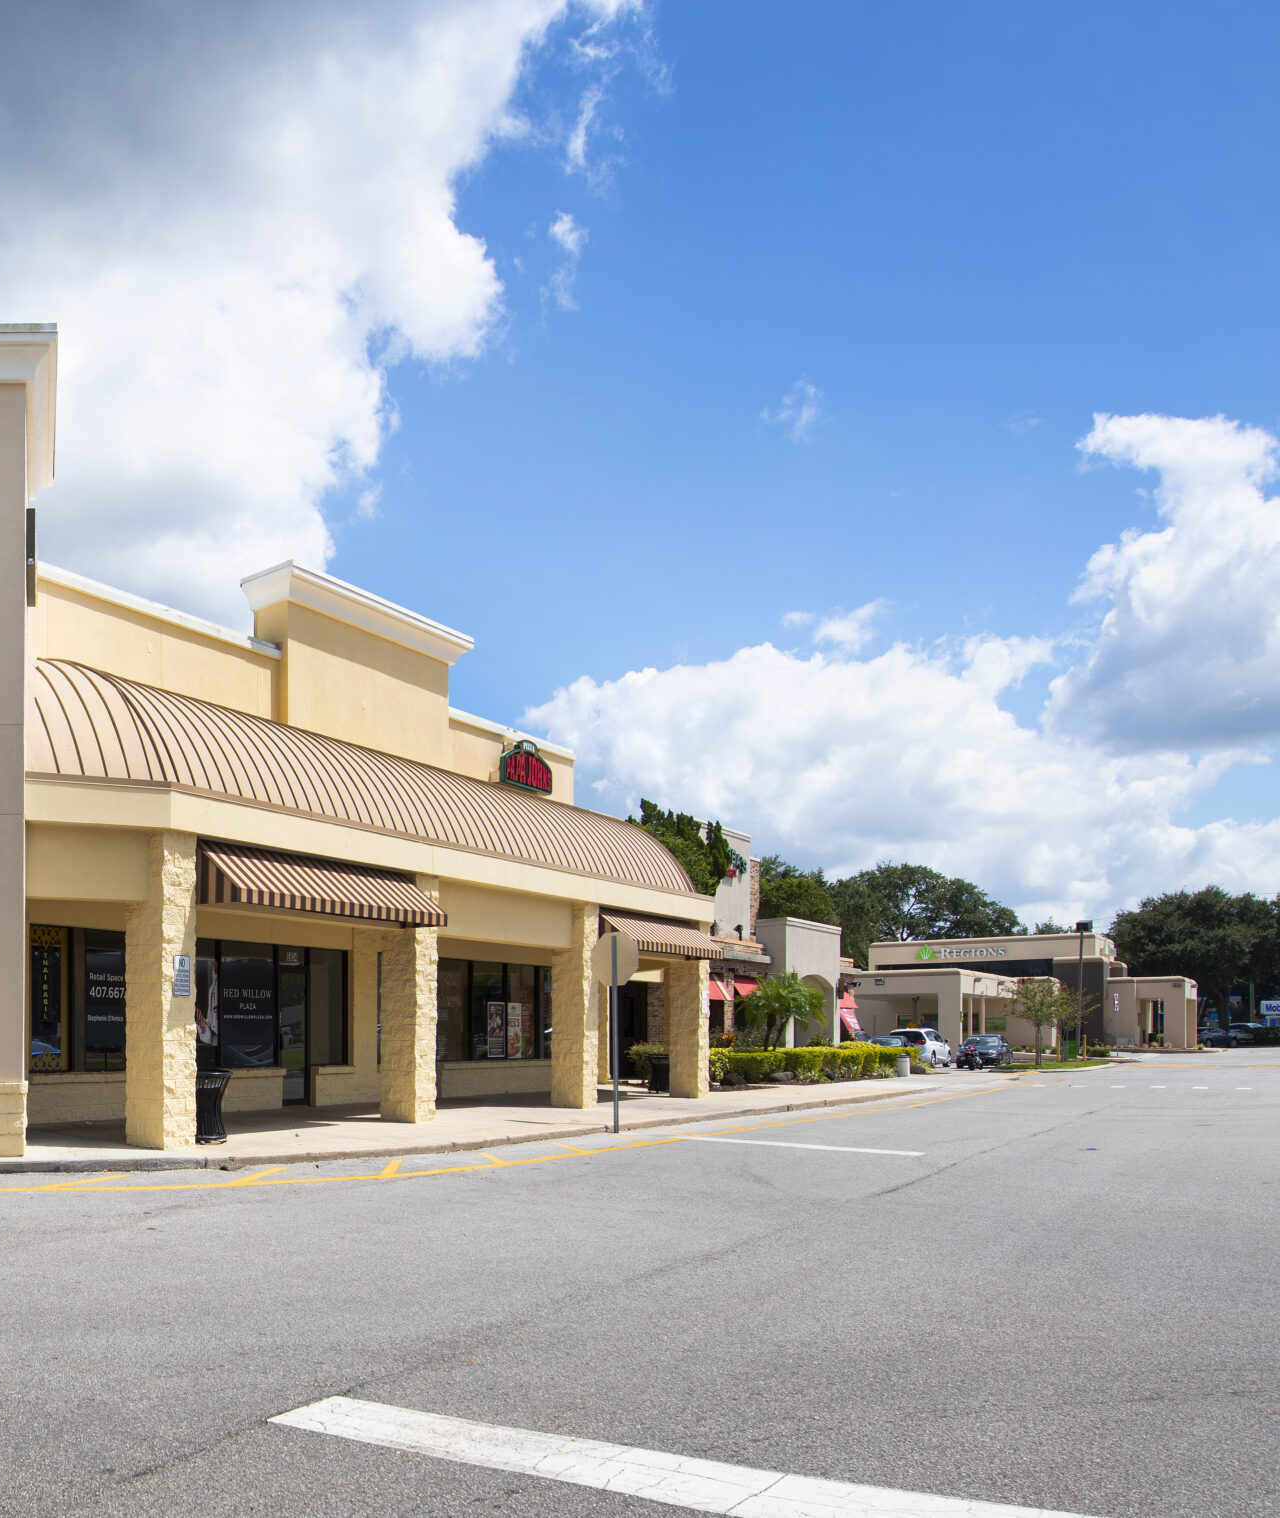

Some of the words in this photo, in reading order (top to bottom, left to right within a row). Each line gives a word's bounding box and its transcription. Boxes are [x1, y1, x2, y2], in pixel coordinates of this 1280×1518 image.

[523, 742, 535, 753] PIZZA
[506, 754, 526, 784] PAPA
[940, 947, 1006, 959] REGIONS
[179, 958, 186, 968] NO
[89, 972, 106, 981] Retail
[106, 973, 124, 983] Space
[223, 988, 240, 999] RED
[241, 989, 272, 999] WILLOW
[239, 1002, 257, 1011] PLAZA
